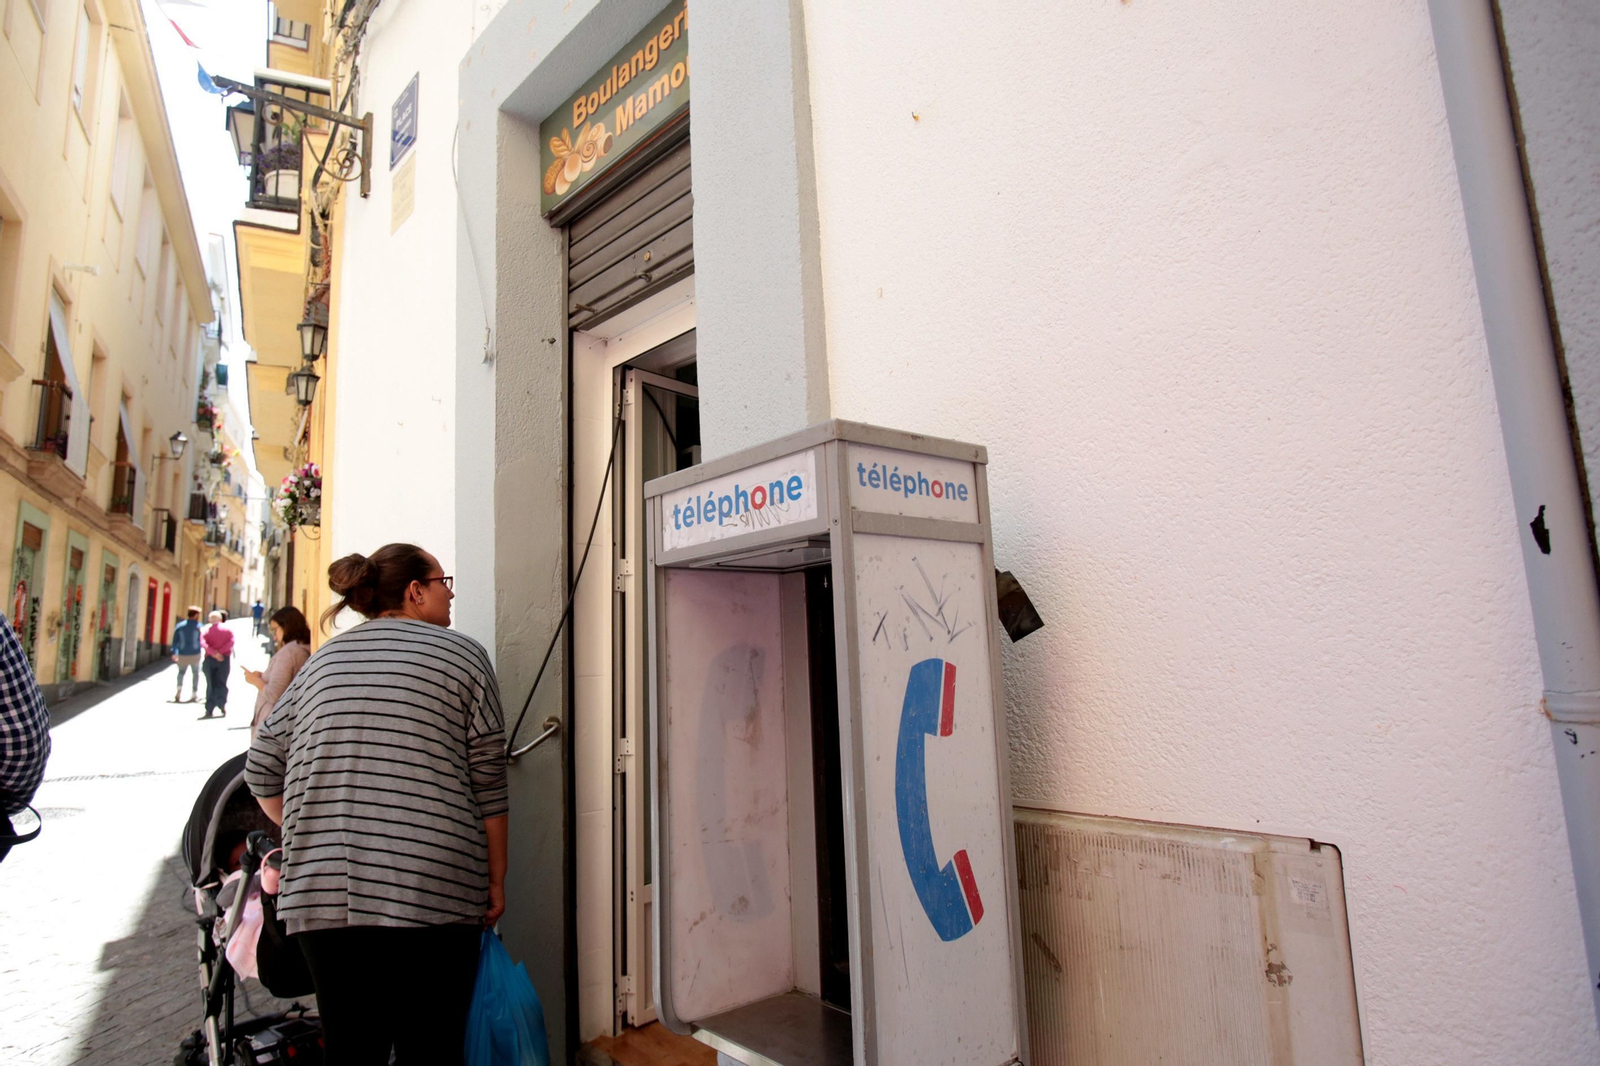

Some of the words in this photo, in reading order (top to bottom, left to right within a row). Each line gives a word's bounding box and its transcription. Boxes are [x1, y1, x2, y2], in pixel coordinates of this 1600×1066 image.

[615, 54, 690, 136] Mamo
[673, 475, 803, 530] téléphone
[857, 462, 968, 502] téléphone
